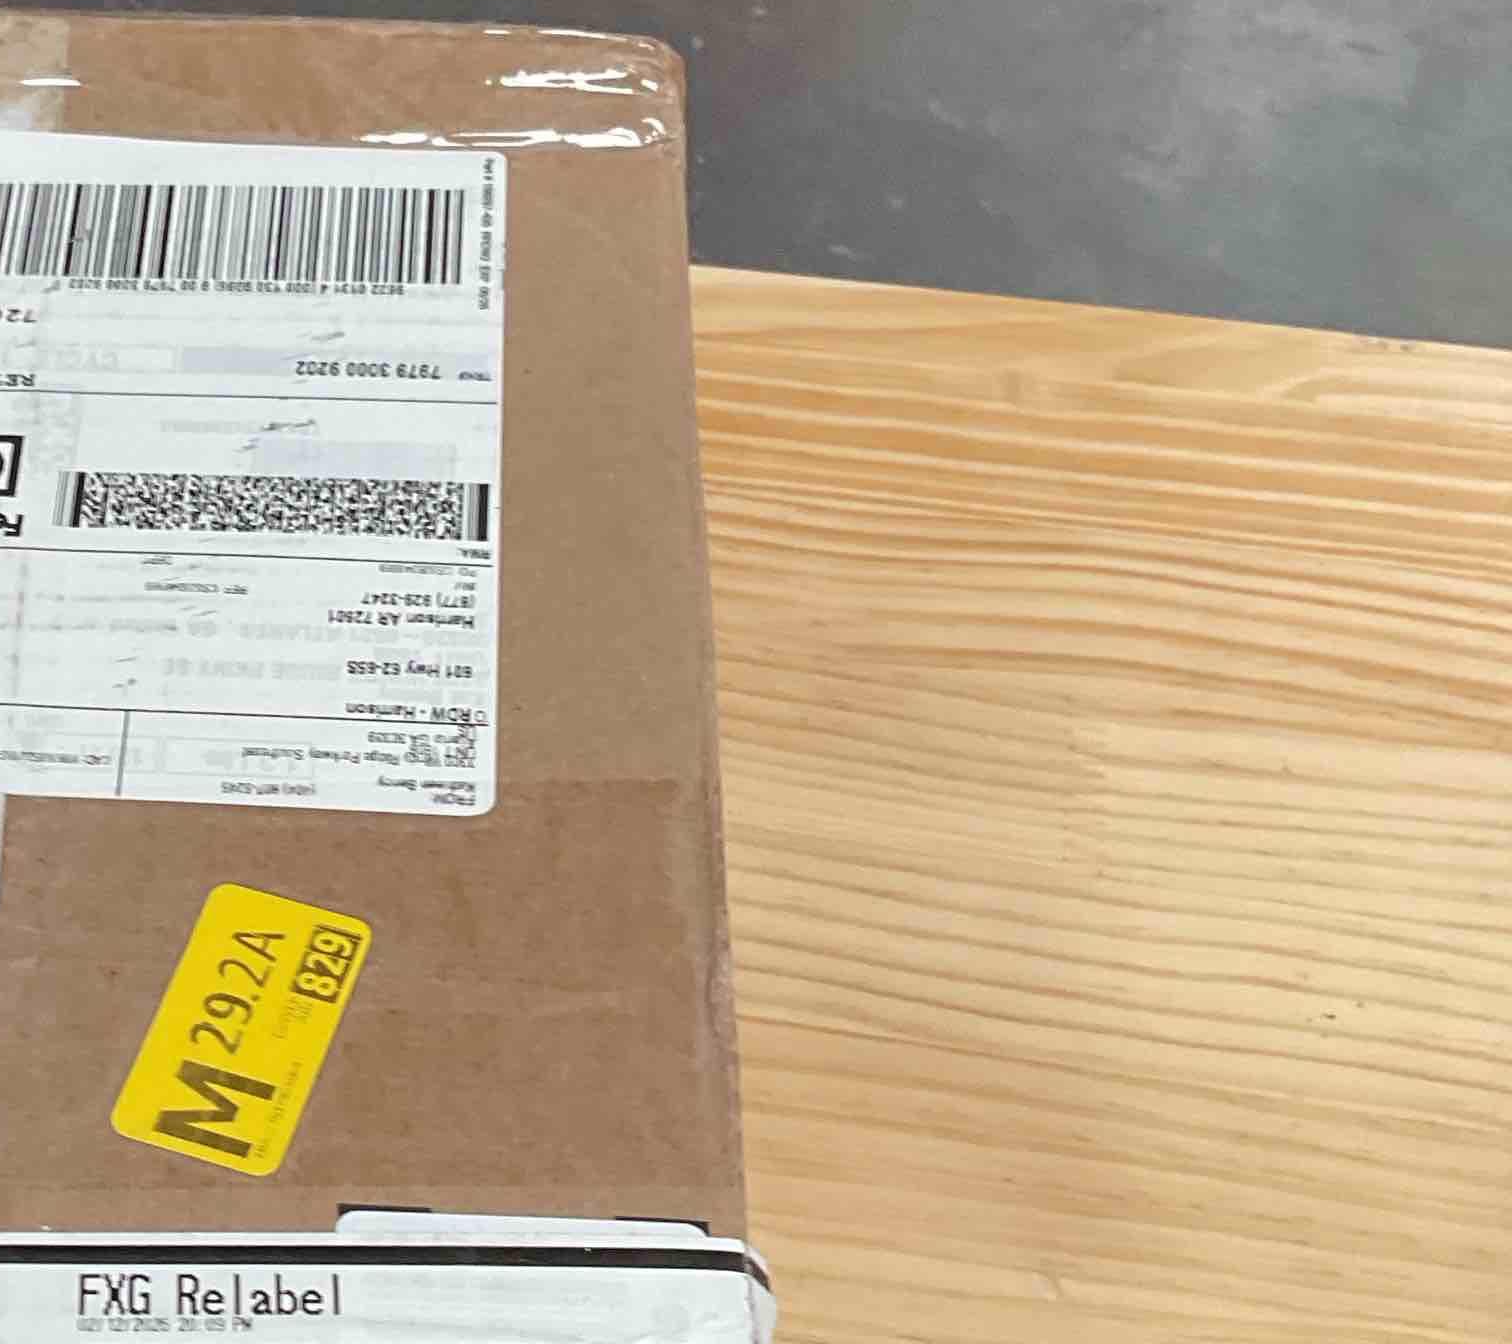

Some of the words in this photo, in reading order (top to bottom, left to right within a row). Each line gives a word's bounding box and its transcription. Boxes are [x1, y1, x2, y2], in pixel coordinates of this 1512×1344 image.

[378, 612, 400, 626] AR
[407, 614, 474, 629] Harrison
[406, 660, 440, 677] Hwy
[345, 704, 415, 719] Harrison
[430, 707, 473, 724] RDW
[151, 1057, 277, 1159] M
[79, 1274, 150, 1319] FXG
[177, 1274, 339, 1319] Relabel
